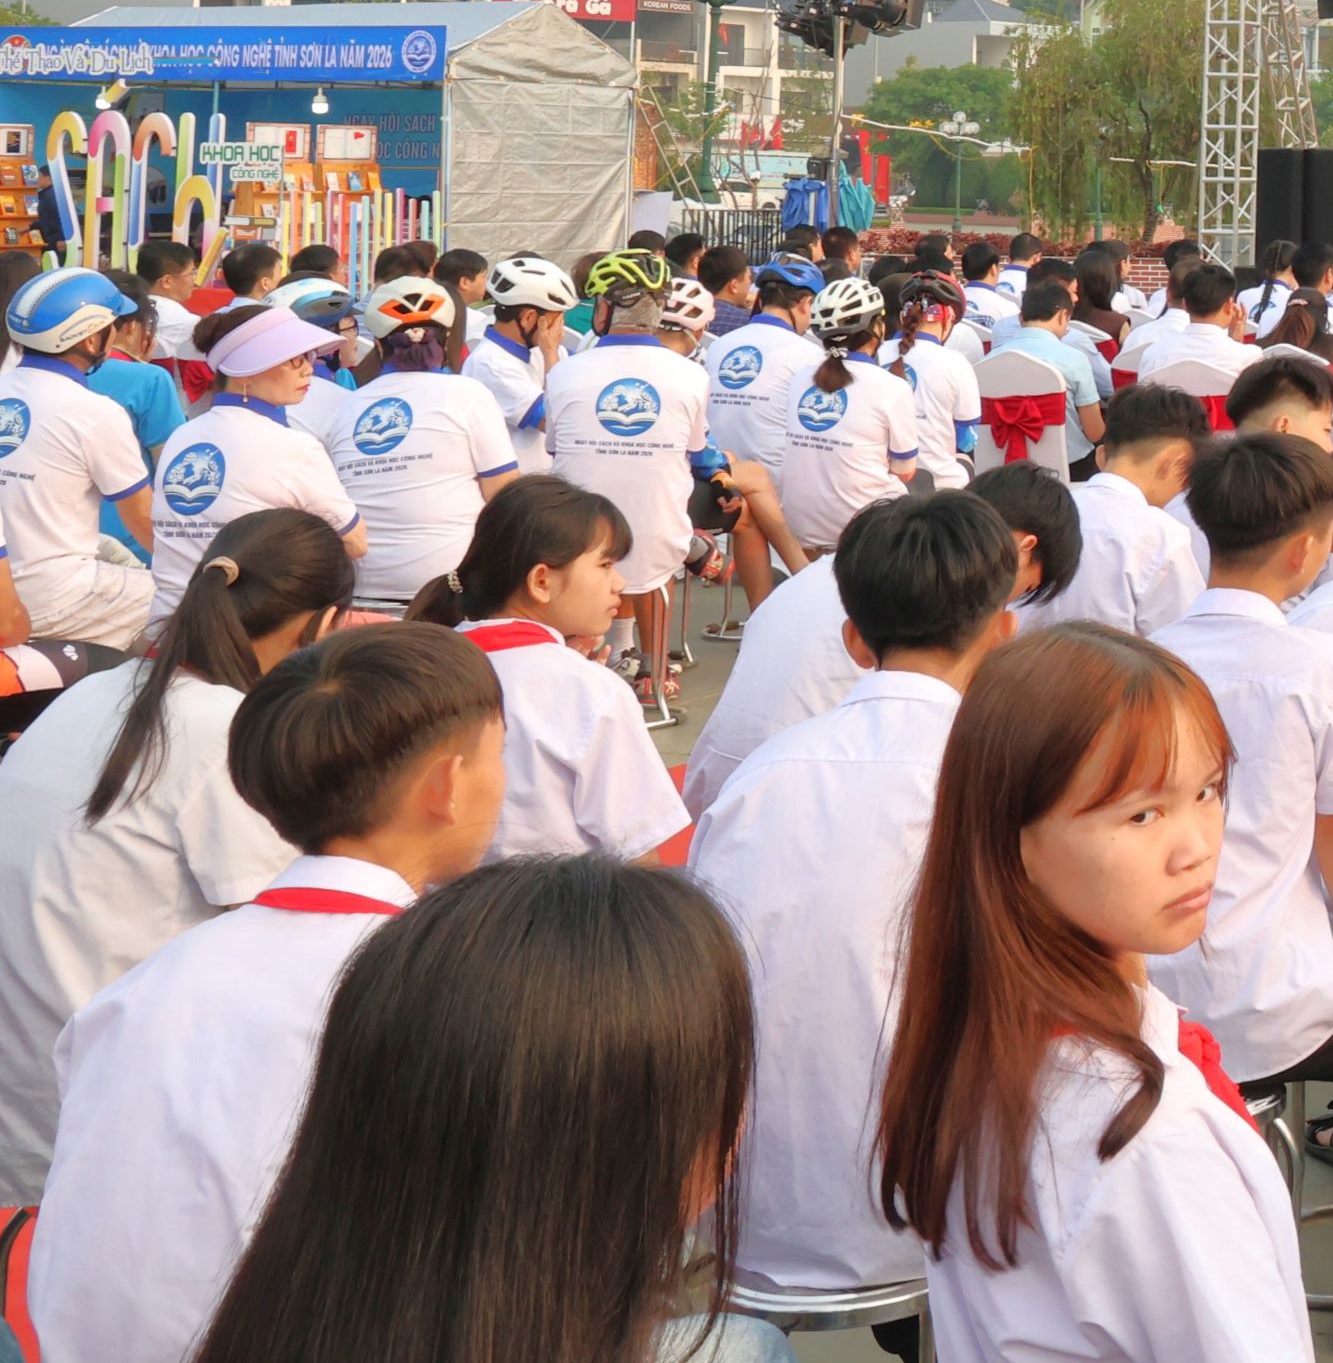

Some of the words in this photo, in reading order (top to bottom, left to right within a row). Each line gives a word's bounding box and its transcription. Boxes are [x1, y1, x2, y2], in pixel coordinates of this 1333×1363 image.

[643, 1, 668, 10] KOREAN
[670, 2, 691, 12] FOODS
[243, 38, 271, 74] NGHỆ
[274, 36, 296, 68] TỈNH
[300, 42, 322, 68] SƠN
[325, 45, 338, 67] LA
[340, 39, 363, 68] NĂM
[367, 45, 392, 68] 2026
[202, 145, 244, 161] KHOA
